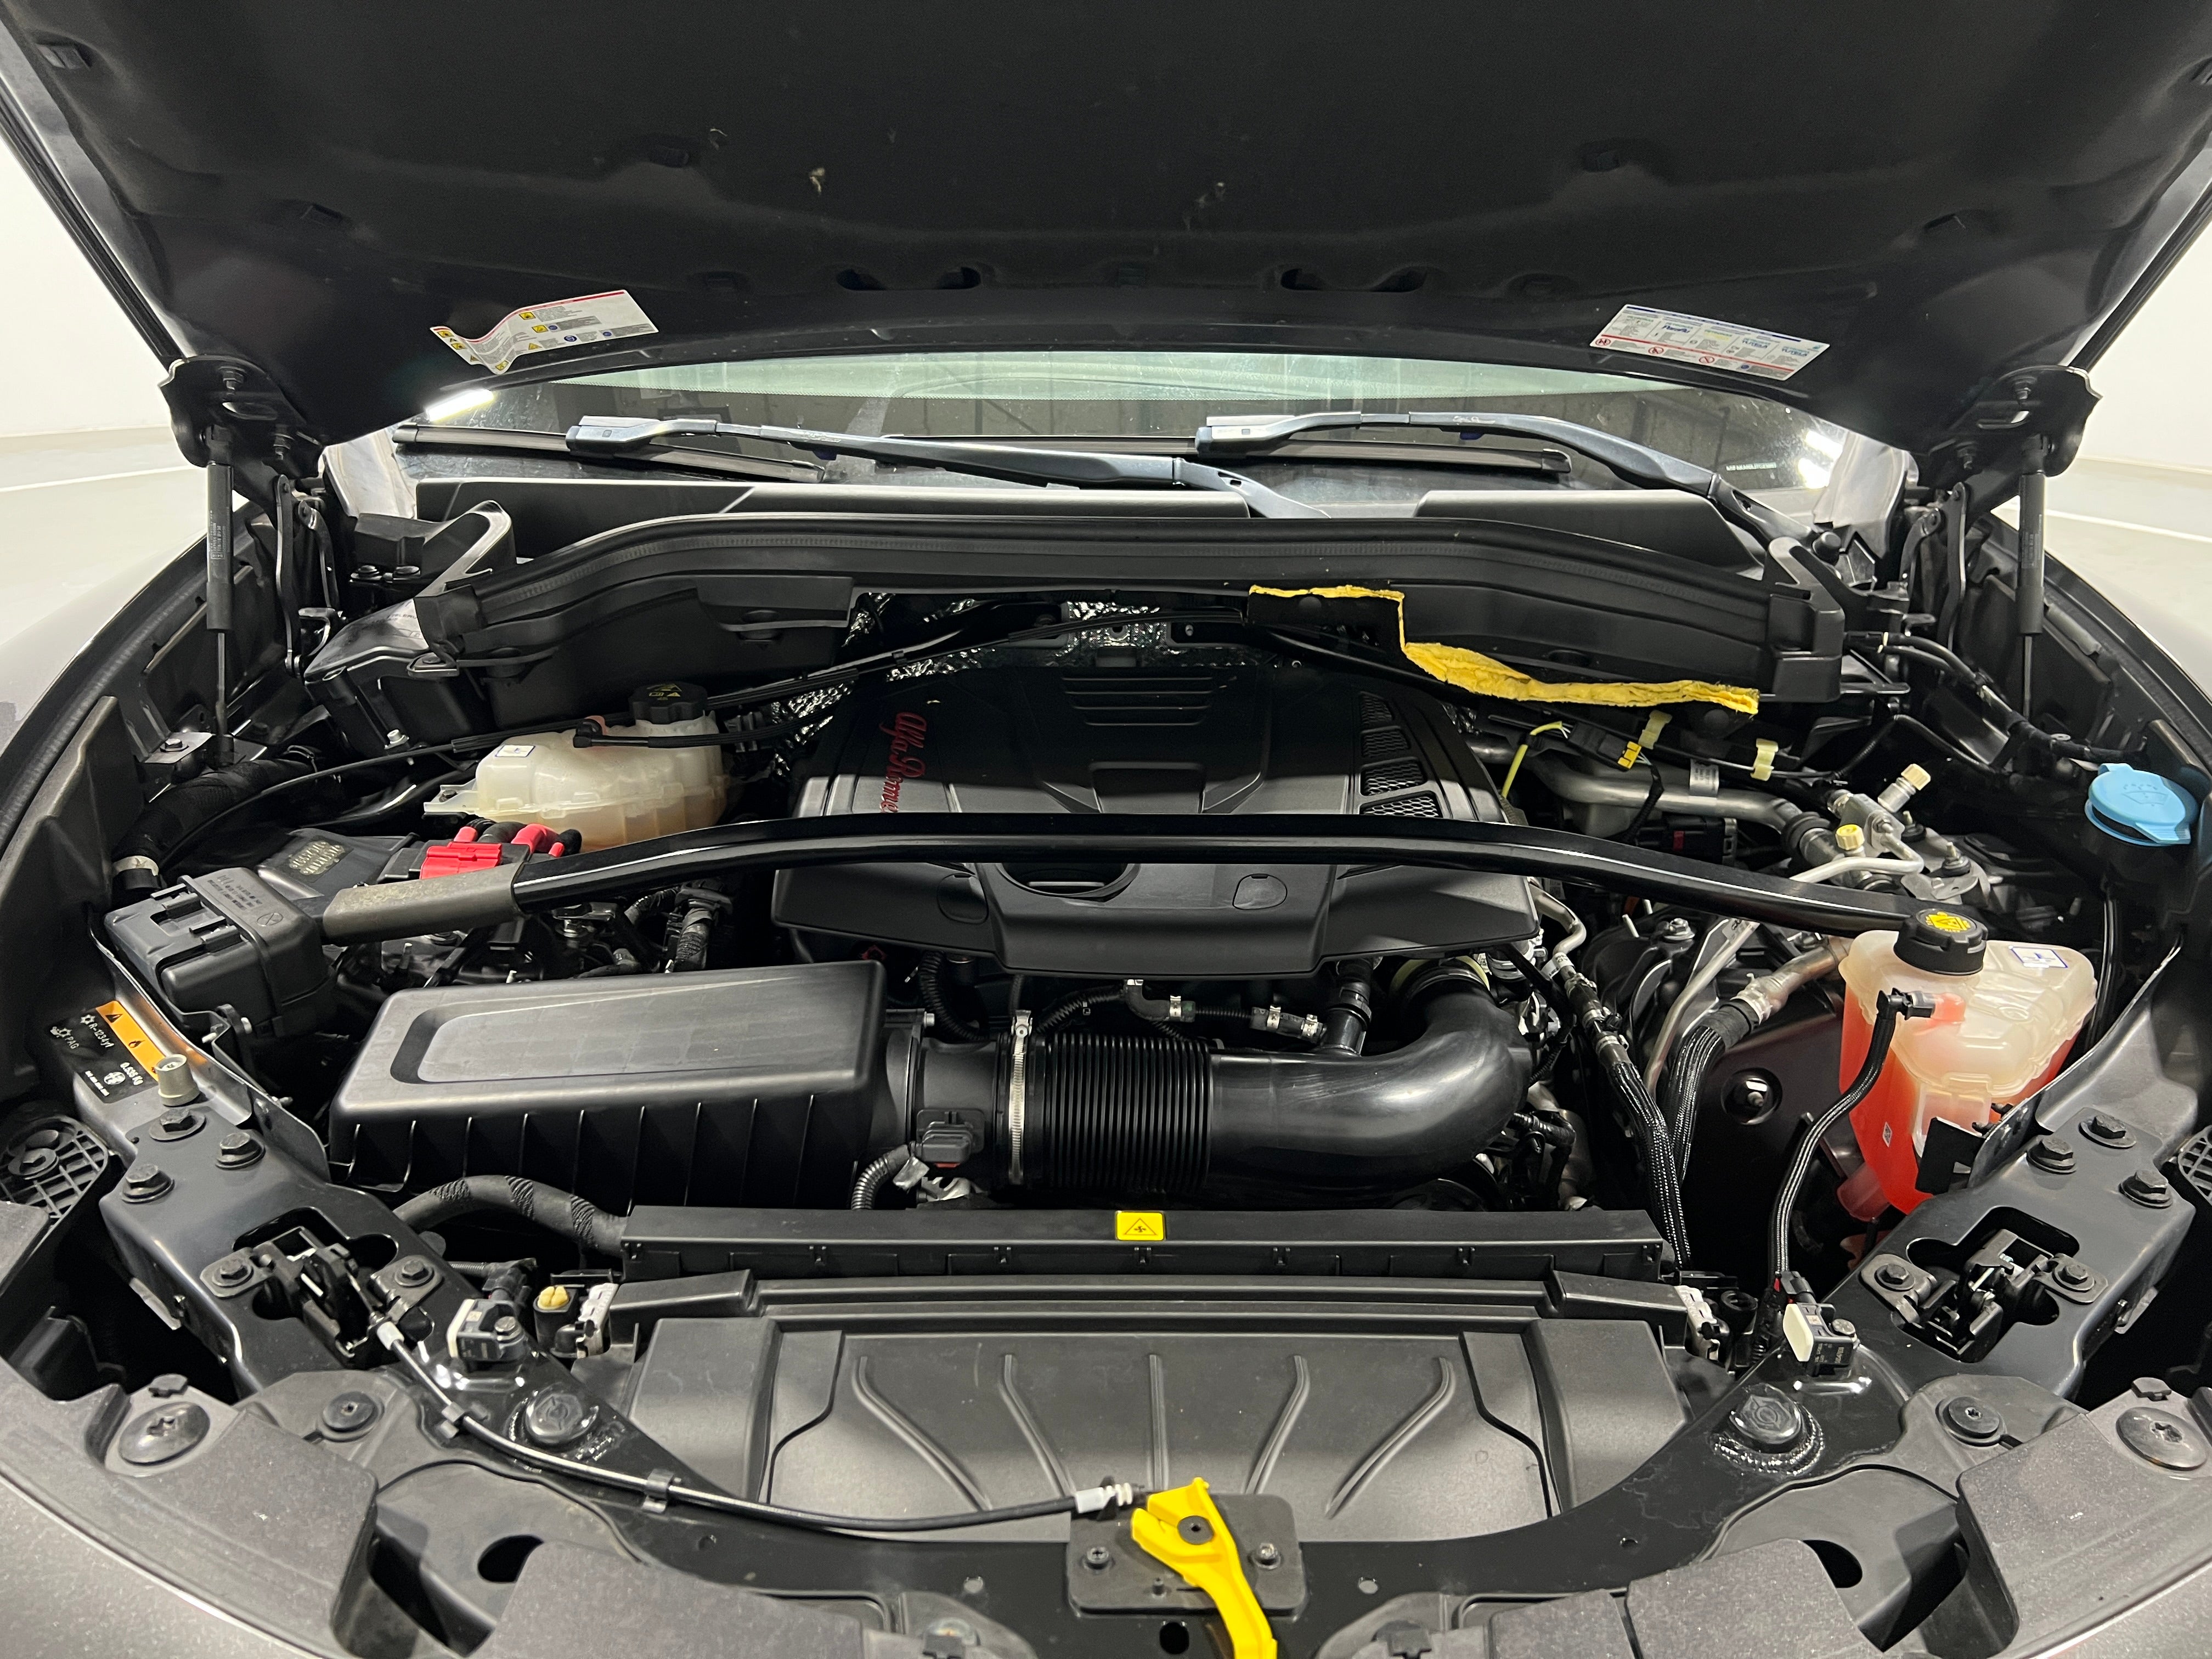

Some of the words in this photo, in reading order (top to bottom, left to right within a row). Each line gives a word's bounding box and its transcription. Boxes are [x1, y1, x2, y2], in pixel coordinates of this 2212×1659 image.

[879, 713, 927, 755] Alfa
[880, 754, 926, 812] Rome
[64, 1036, 80, 1049] PAG
